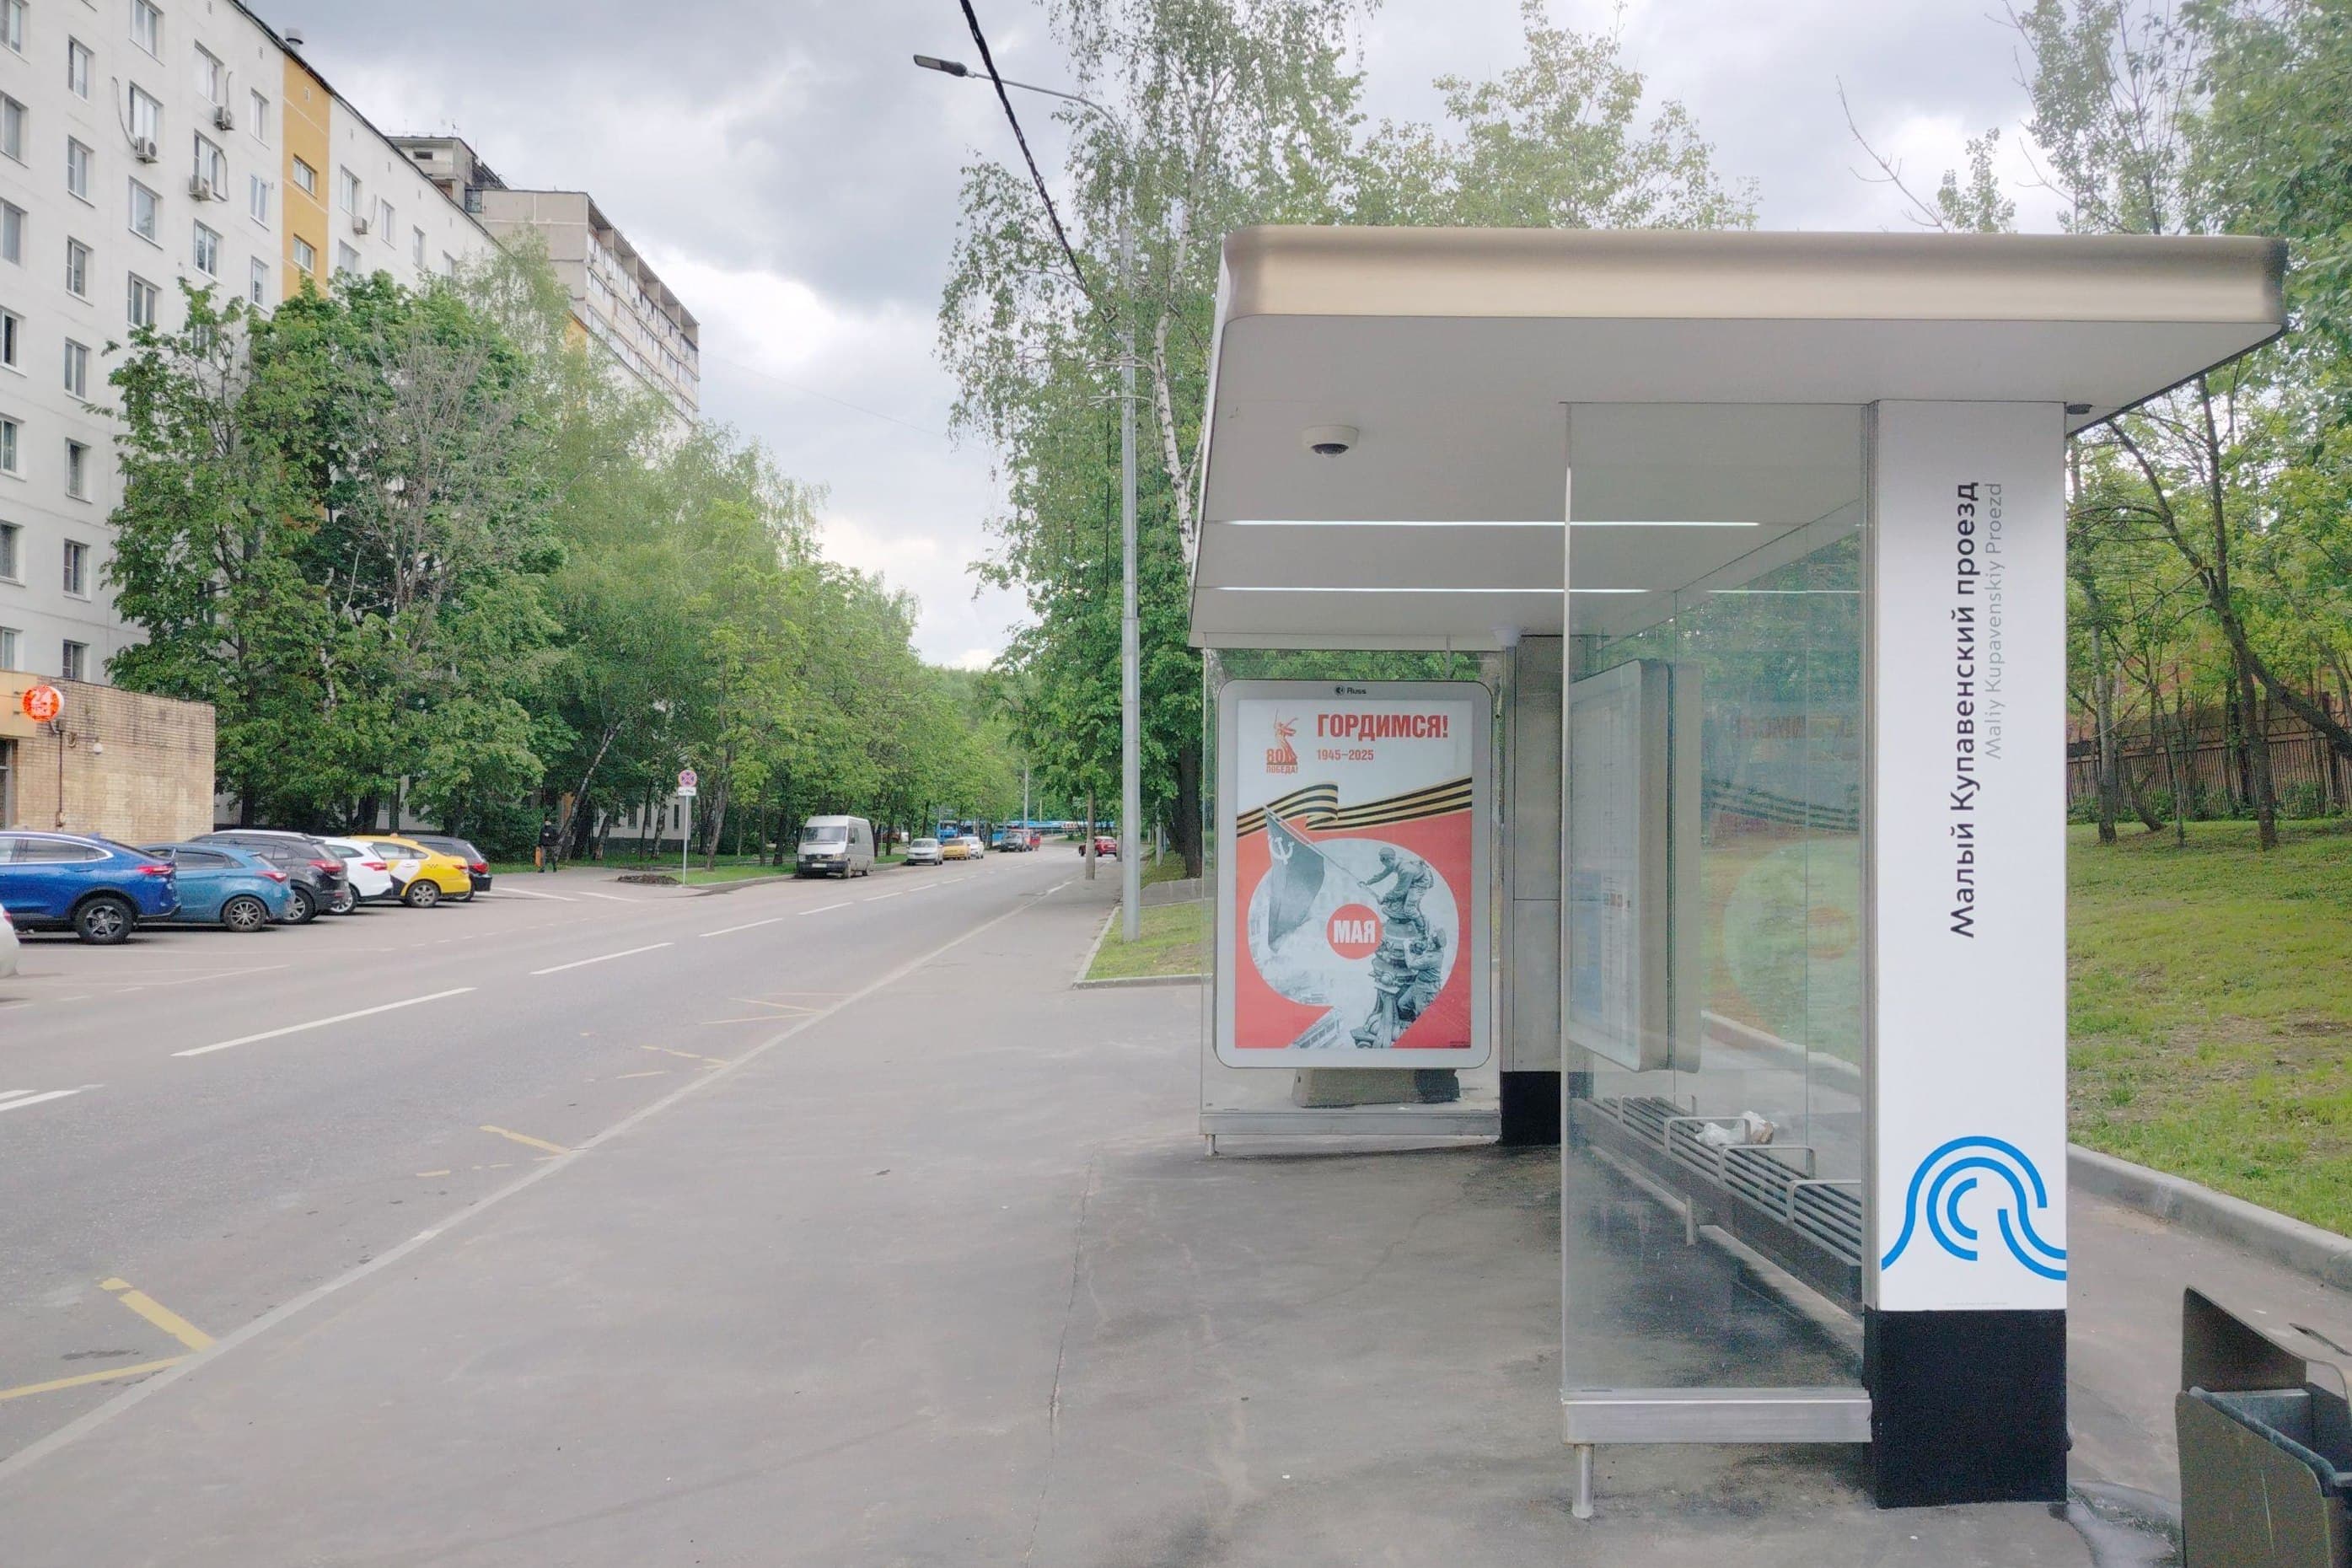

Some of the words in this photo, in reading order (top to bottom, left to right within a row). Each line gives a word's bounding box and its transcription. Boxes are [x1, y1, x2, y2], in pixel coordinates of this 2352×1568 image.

[1957, 481, 1980, 595] проезд
[1984, 483, 2002, 554] Proezd
[1984, 560, 2006, 693] Kupavenskiy
[1346, 686, 1367, 695] Russ
[1950, 606, 1980, 810] Купавенский
[1266, 748, 1284, 763] 80
[1317, 713, 1449, 742] ГОРДИМСЯ!
[1984, 699, 2006, 760] Maliy
[1950, 823, 1975, 937] Малый
[1334, 920, 1376, 944] МАЯ
